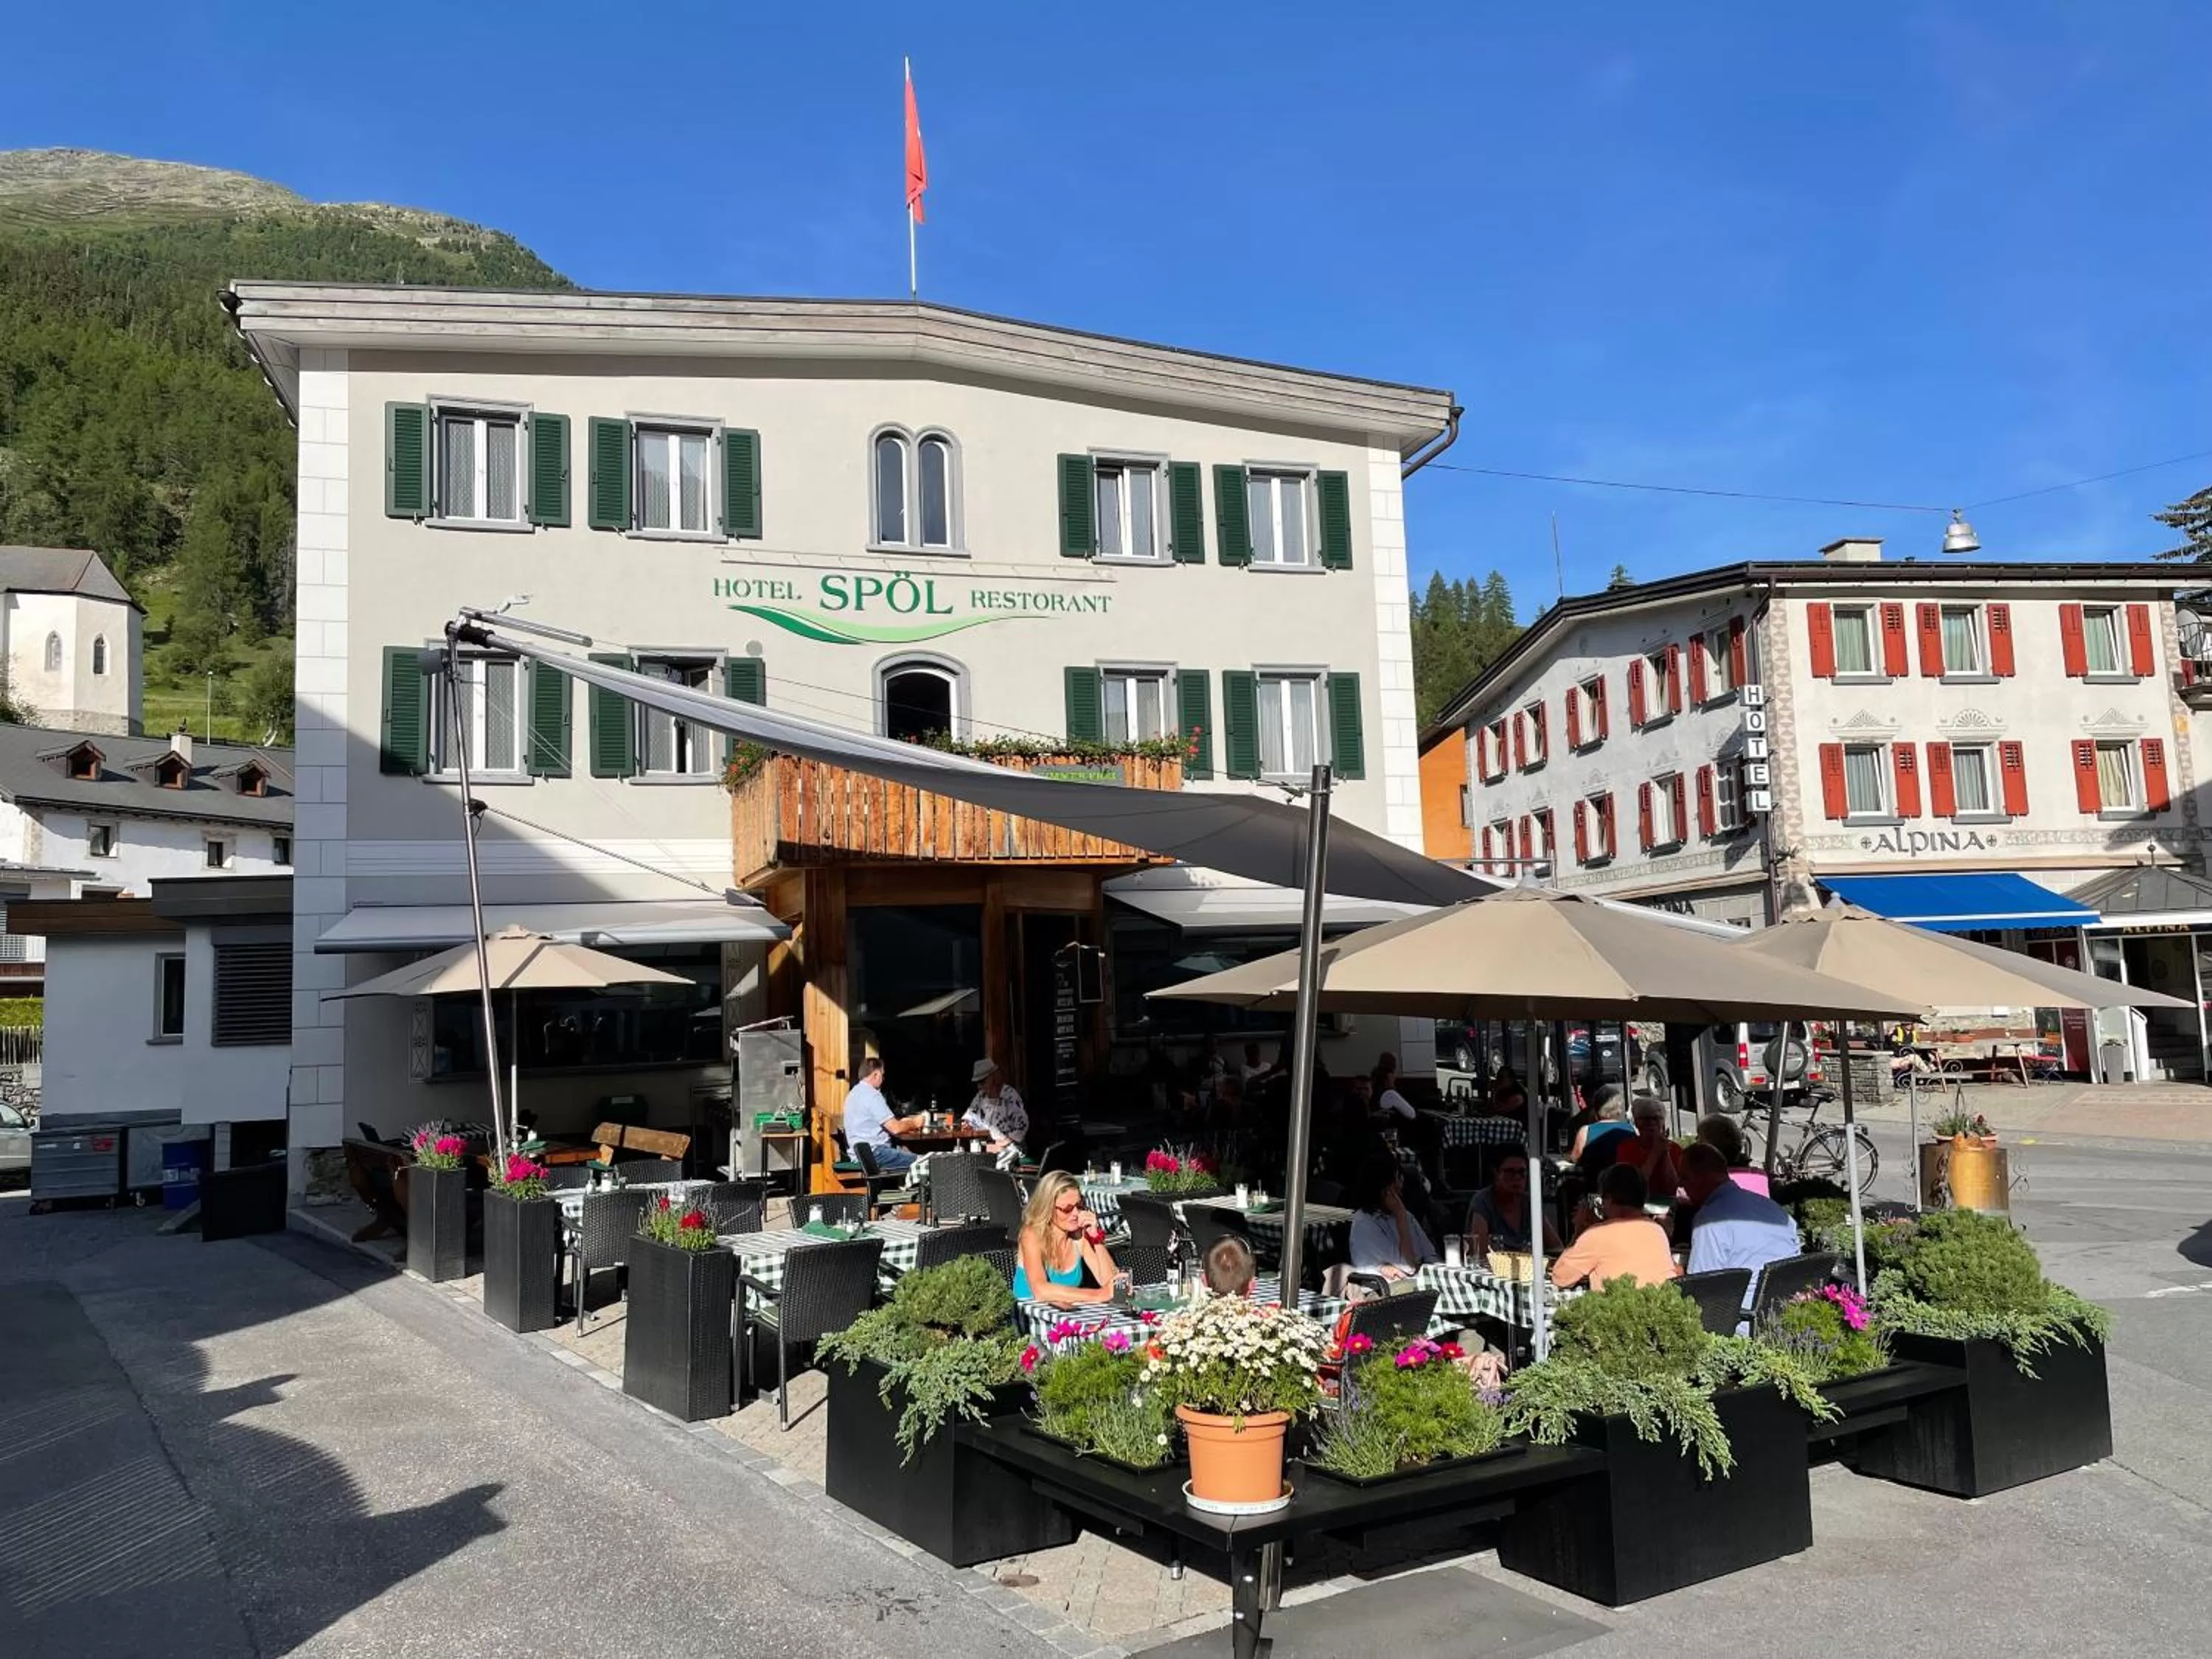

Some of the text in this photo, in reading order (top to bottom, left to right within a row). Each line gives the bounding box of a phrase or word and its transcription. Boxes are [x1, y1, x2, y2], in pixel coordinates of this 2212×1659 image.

[713, 570, 1112, 614] HOTEL SPÖL RESTORANT
[1747, 686, 1767, 809] HOTEL
